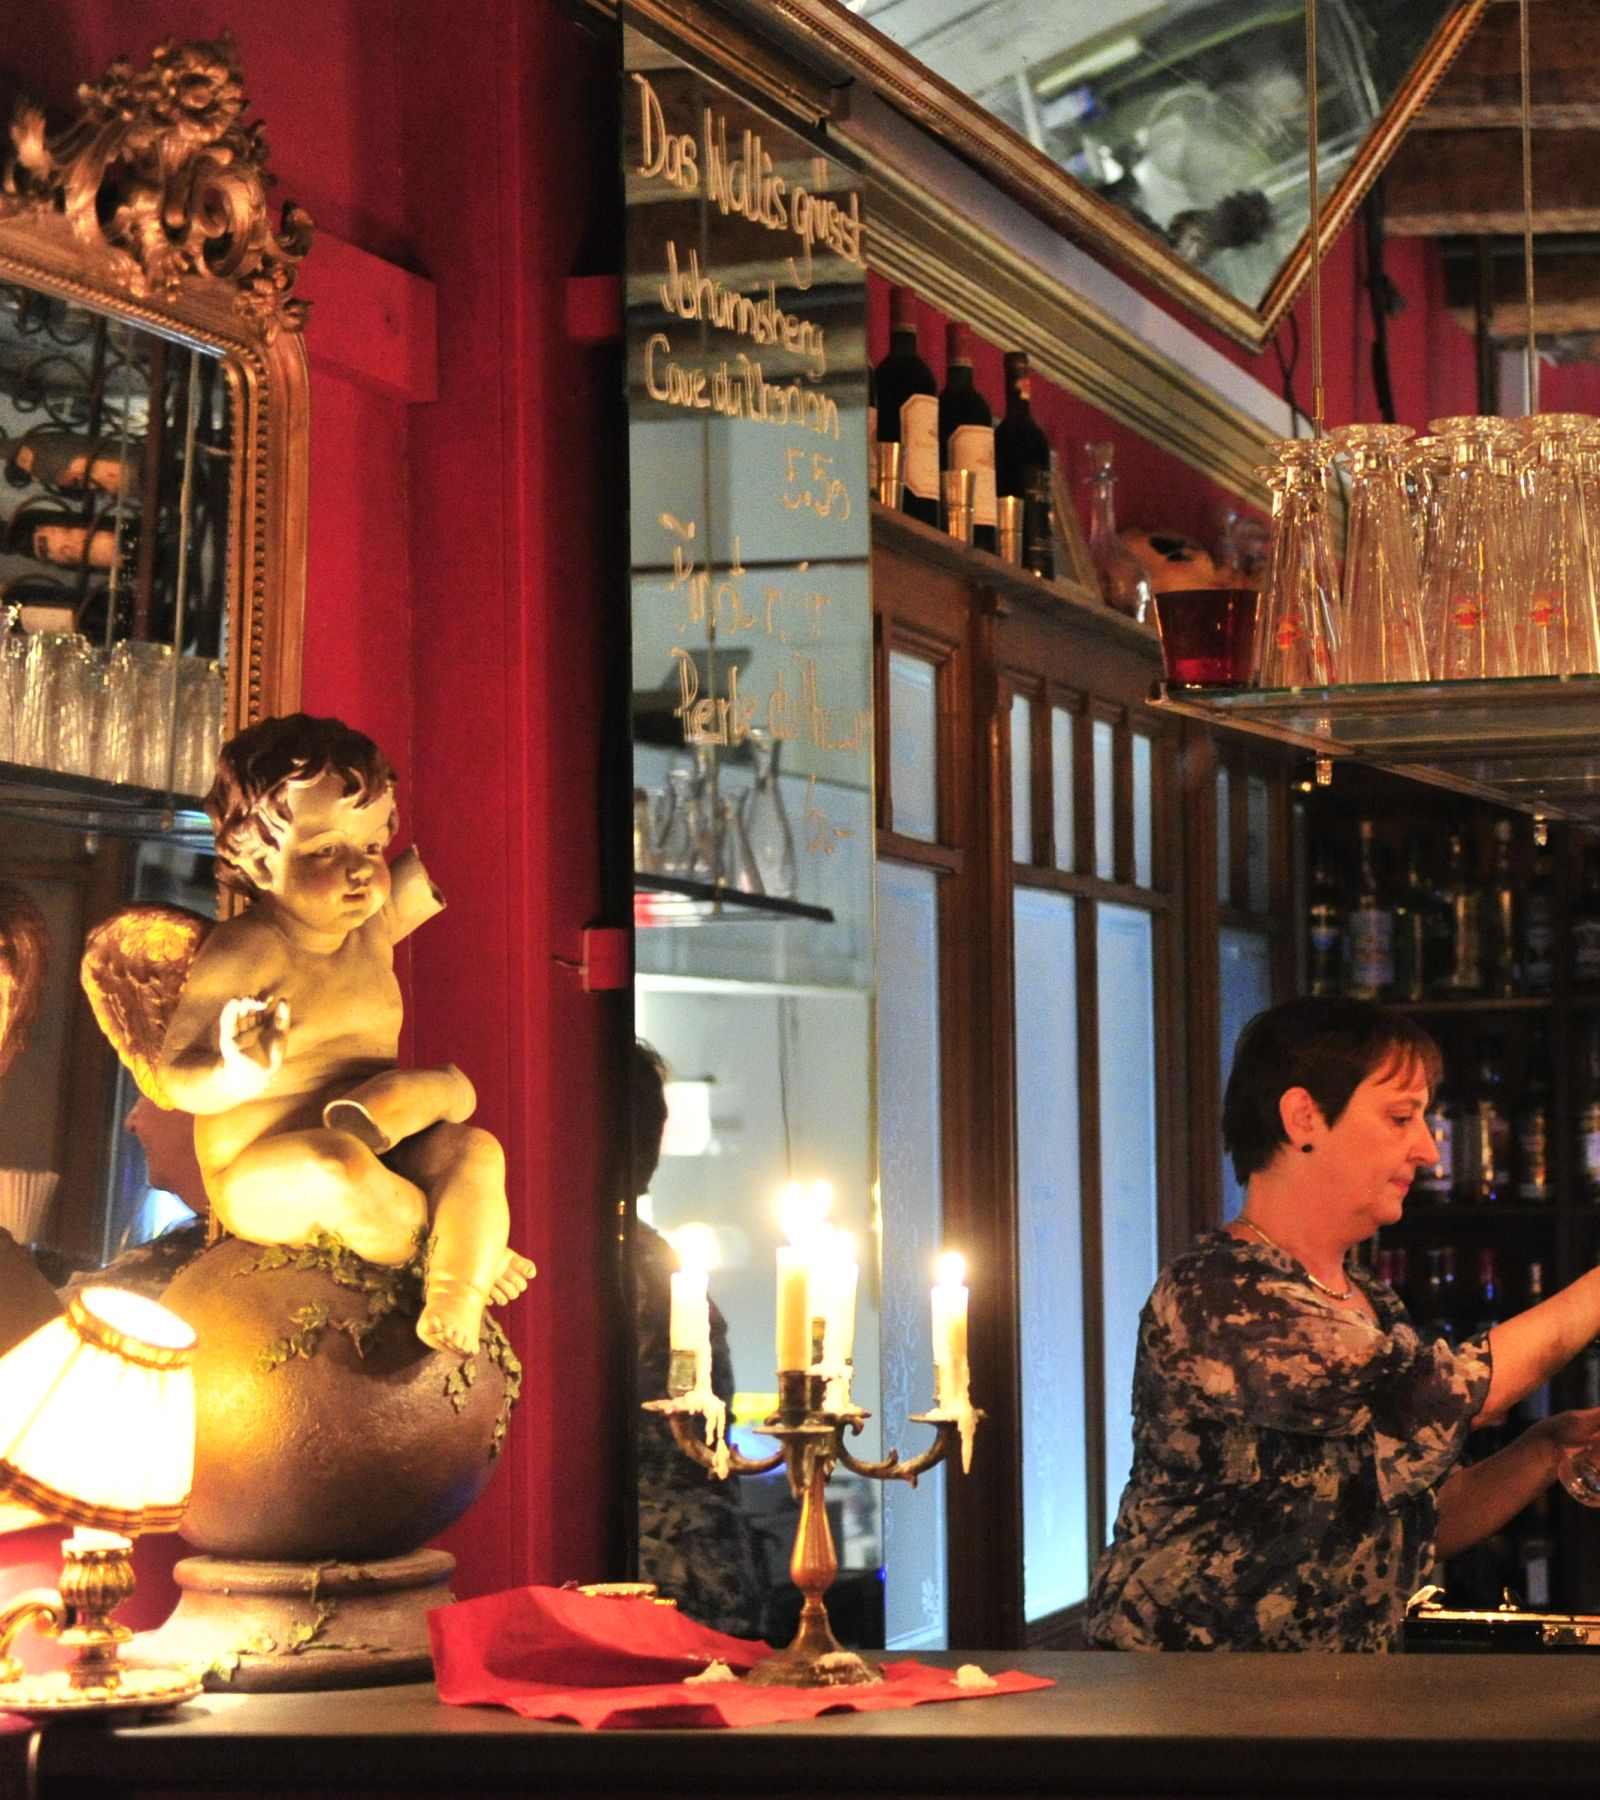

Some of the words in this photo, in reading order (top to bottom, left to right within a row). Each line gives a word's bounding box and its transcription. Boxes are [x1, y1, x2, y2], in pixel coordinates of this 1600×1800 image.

[632, 72, 698, 193] Das
[703, 107, 788, 231] Wallis
[645, 333, 711, 407] Cave
